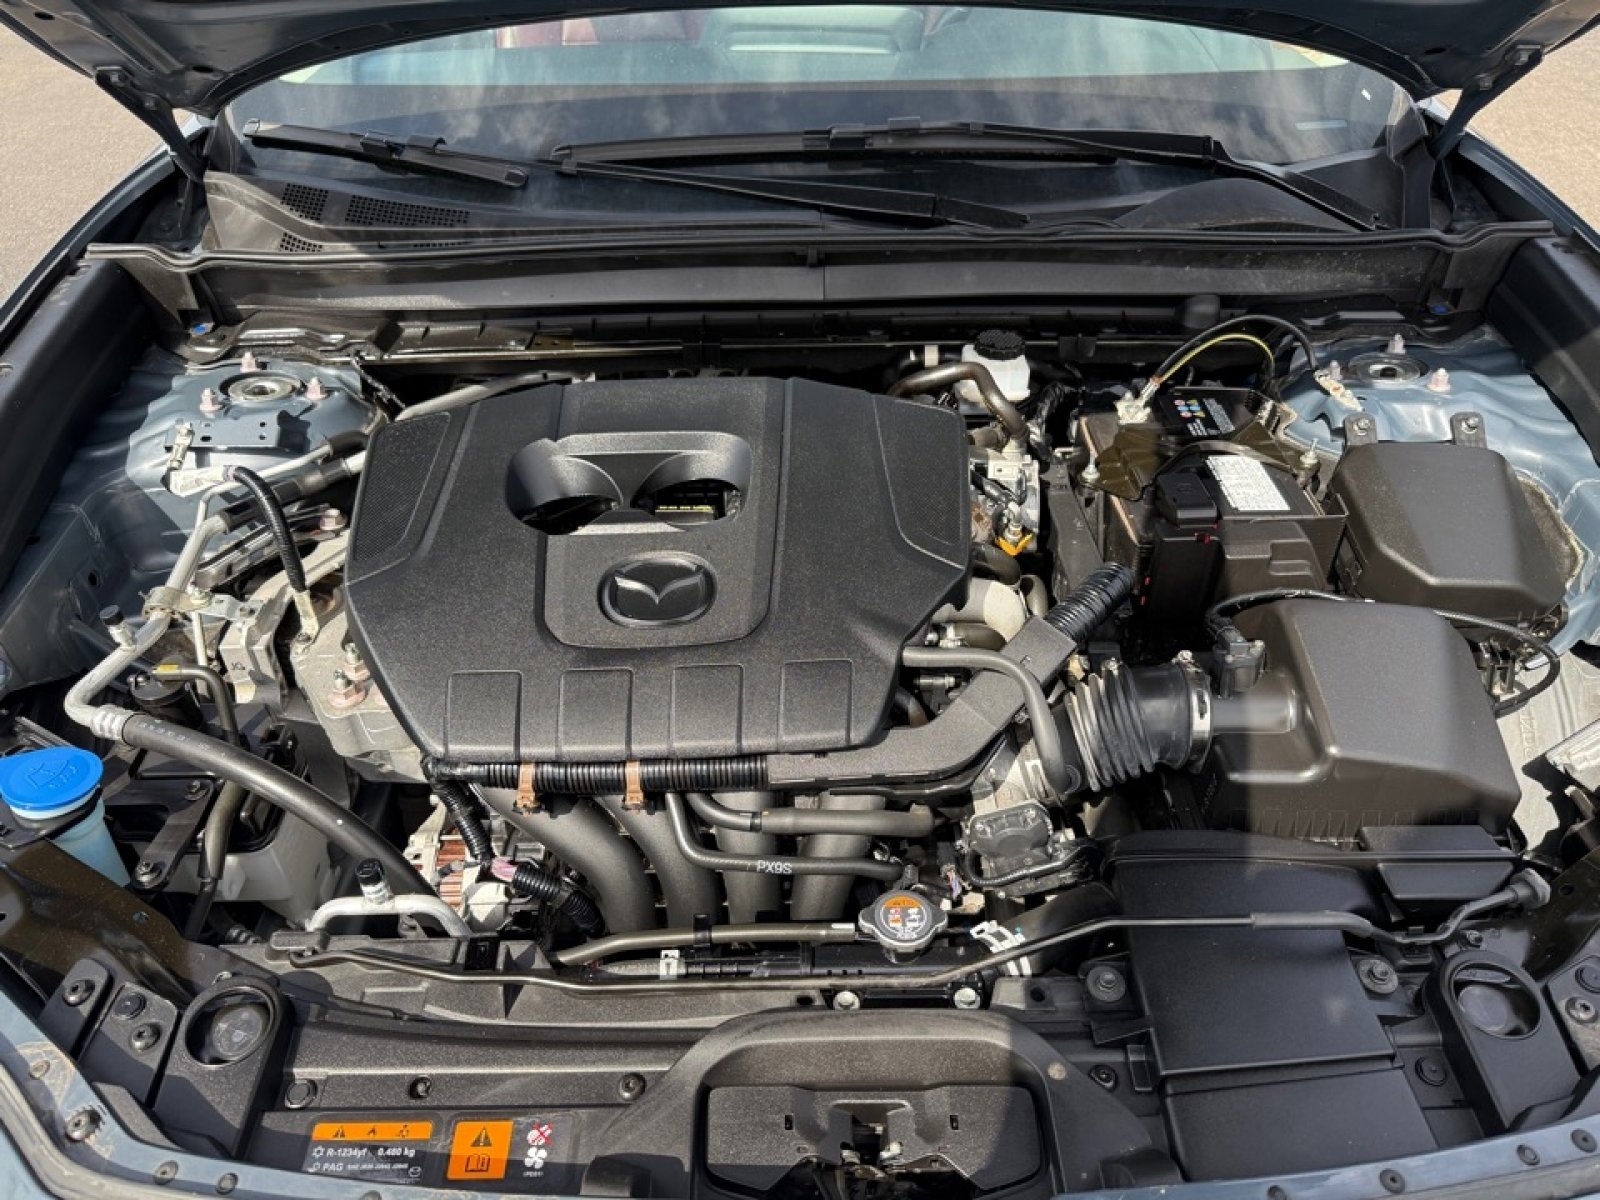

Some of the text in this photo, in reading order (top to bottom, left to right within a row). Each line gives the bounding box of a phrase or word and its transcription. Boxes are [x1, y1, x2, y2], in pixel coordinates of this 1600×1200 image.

[326, 1147, 368, 1159] R-1234yf
[402, 1147, 415, 1158] kg
[322, 1162, 344, 1171] PAG
